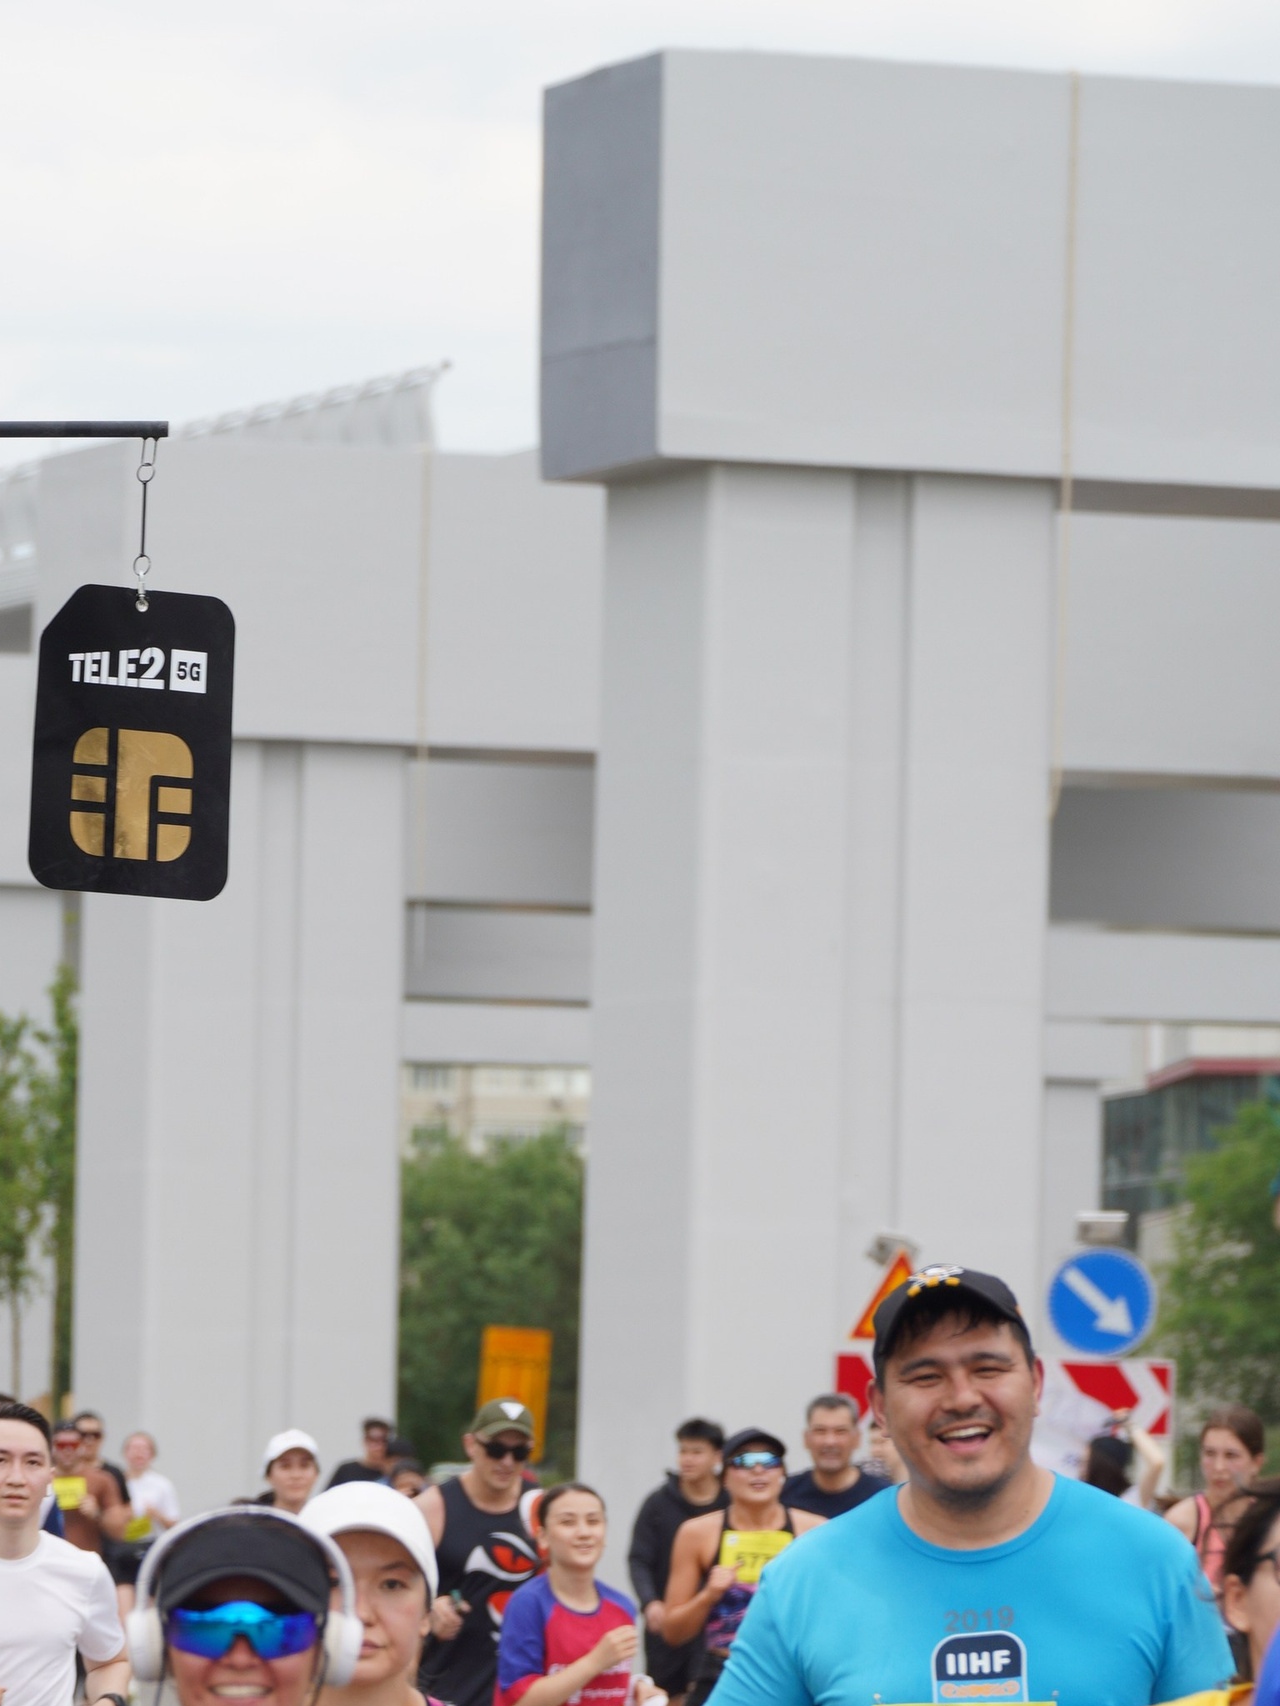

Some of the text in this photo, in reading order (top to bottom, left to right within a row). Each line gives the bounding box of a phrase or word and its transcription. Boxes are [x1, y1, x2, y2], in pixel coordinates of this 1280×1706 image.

[68, 647, 202, 690] TELE2 5G
[943, 1605, 1015, 1633] 2019
[945, 1649, 1012, 1676] IIHF
